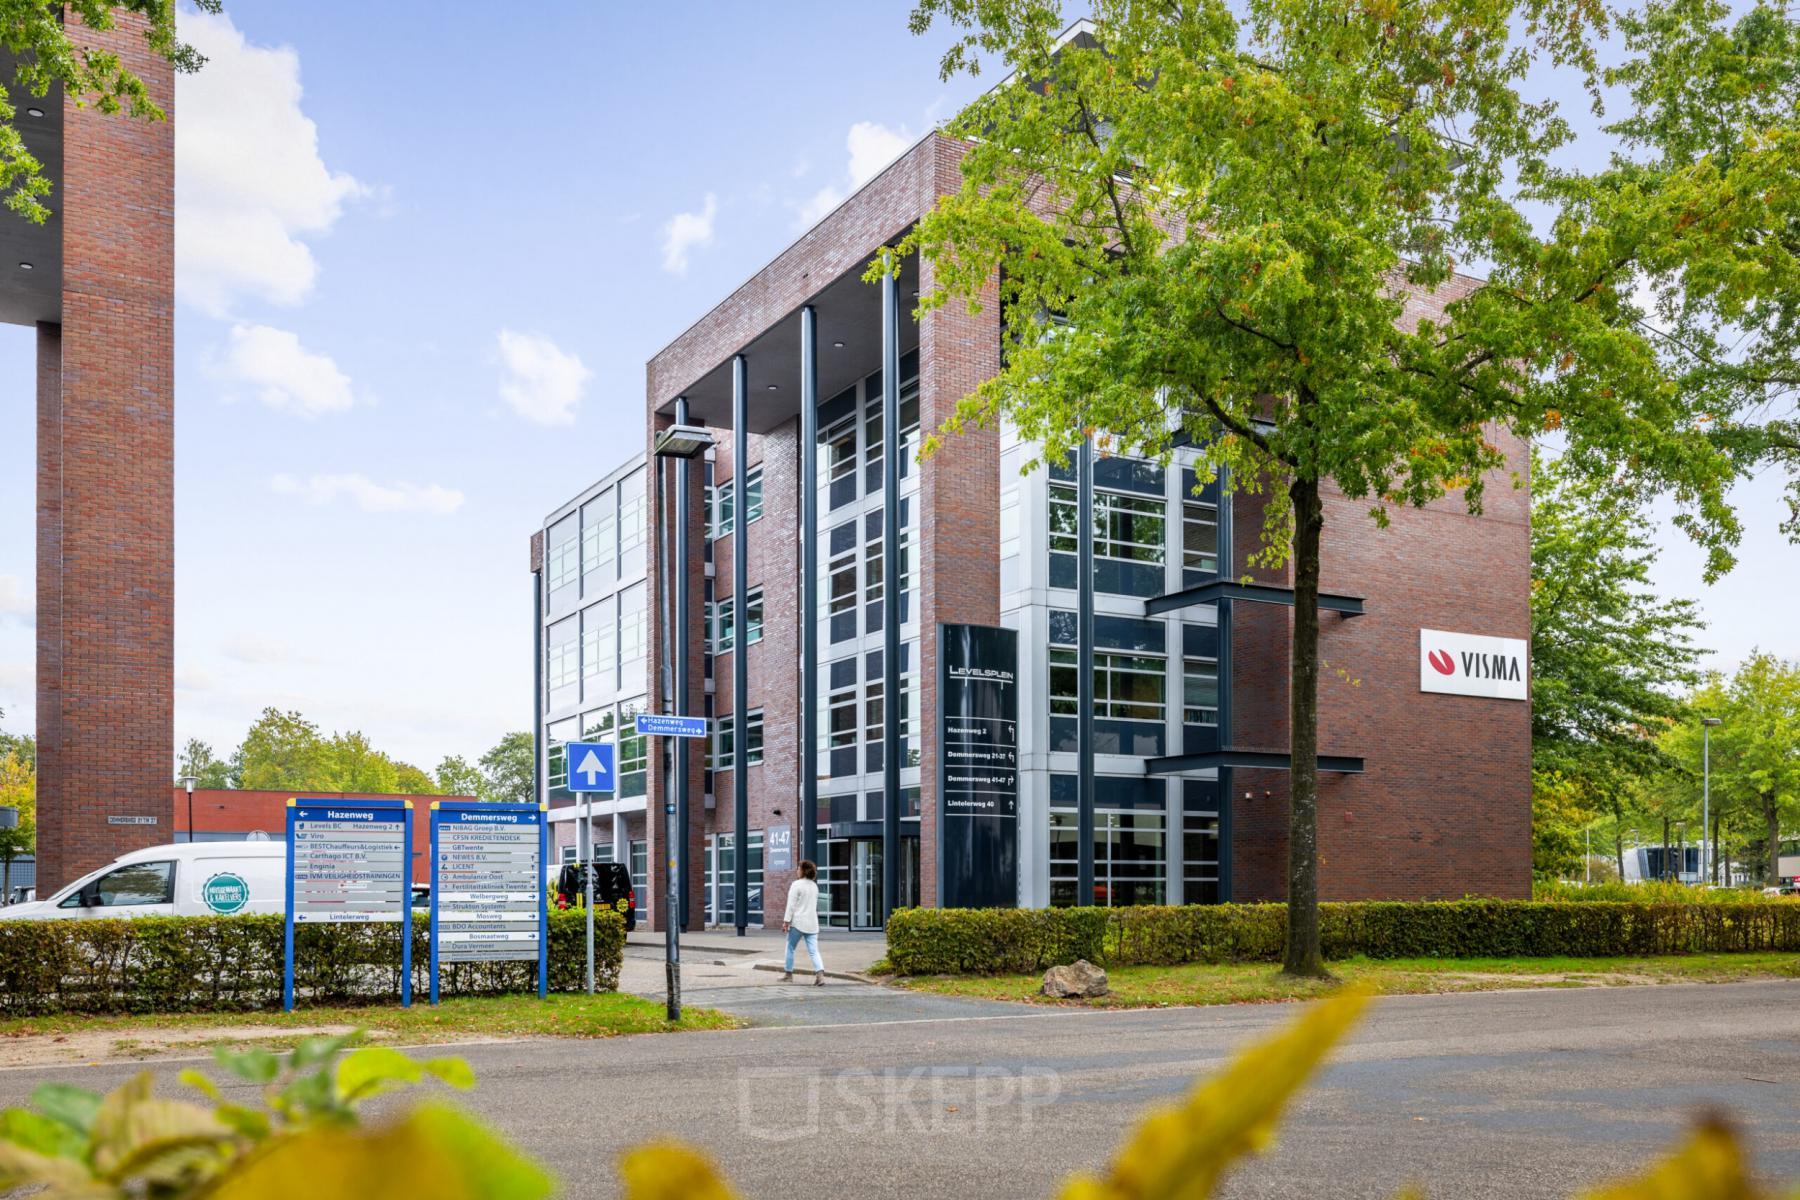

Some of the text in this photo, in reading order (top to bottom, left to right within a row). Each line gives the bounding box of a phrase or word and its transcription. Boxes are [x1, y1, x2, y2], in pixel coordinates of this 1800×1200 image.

[1461, 651, 1521, 682] VISMA
[648, 716, 684, 726] Hazenweg
[648, 724, 696, 735] Demmersweg
[947, 727, 982, 735] Hazenweg
[947, 751, 991, 760] Demmersweg
[947, 775, 991, 784] Demmersweg
[947, 800, 986, 808] Lintelerweg
[327, 810, 374, 821] Hazenweg
[461, 813, 518, 823] Demmersweg
[352, 823, 387, 831] Hazenweg
[770, 831, 790, 846] 41-47
